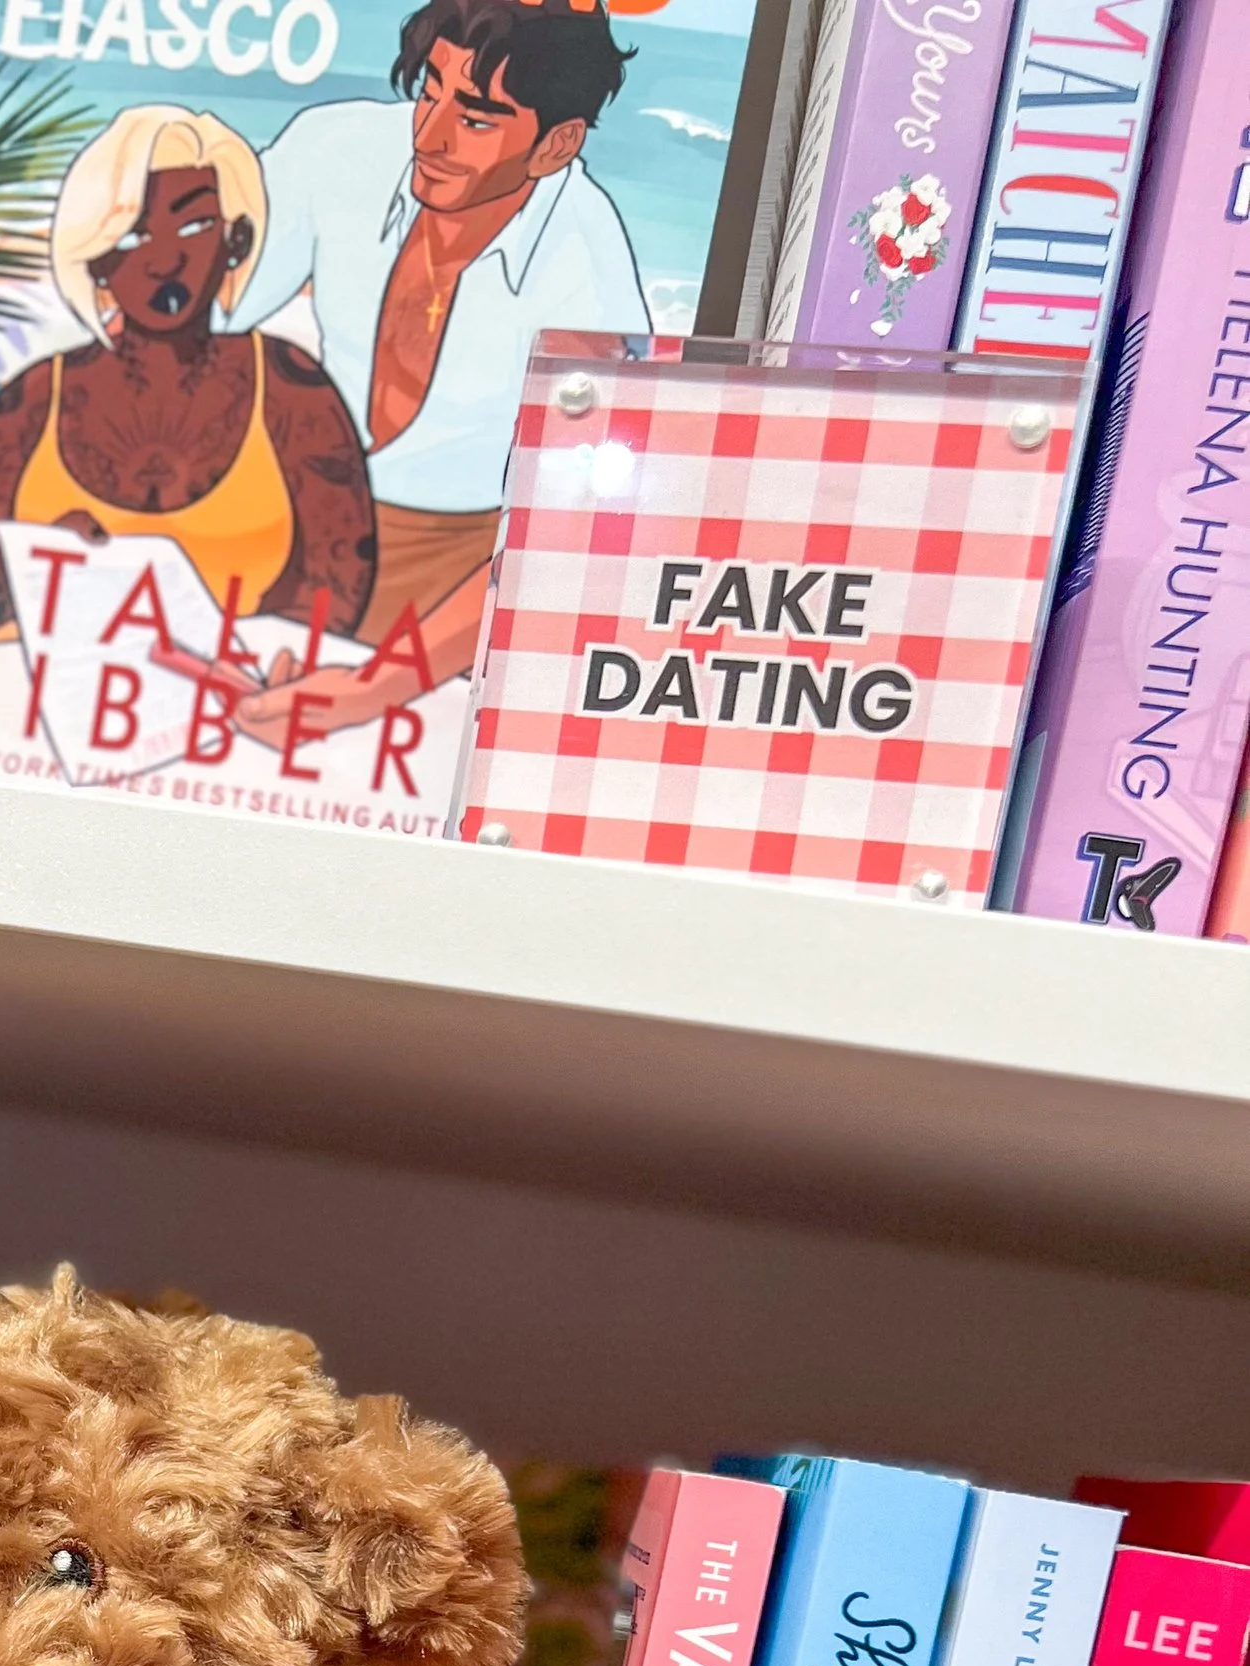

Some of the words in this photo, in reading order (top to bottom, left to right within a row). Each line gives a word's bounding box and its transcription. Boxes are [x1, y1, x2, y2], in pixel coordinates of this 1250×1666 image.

[884, 0, 982, 154] Yours
[30, 546, 436, 692] TALIA
[652, 562, 874, 640] FAKE
[582, 649, 914, 734] DATING
[1121, 516, 1229, 801] HUNTING
[73, 763, 165, 799] TIMES
[172, 777, 372, 831] BESTSELLING
[695, 1539, 739, 1606] THE
[1022, 1542, 1060, 1646] JENNY
[1124, 1610, 1219, 1661] LEE
